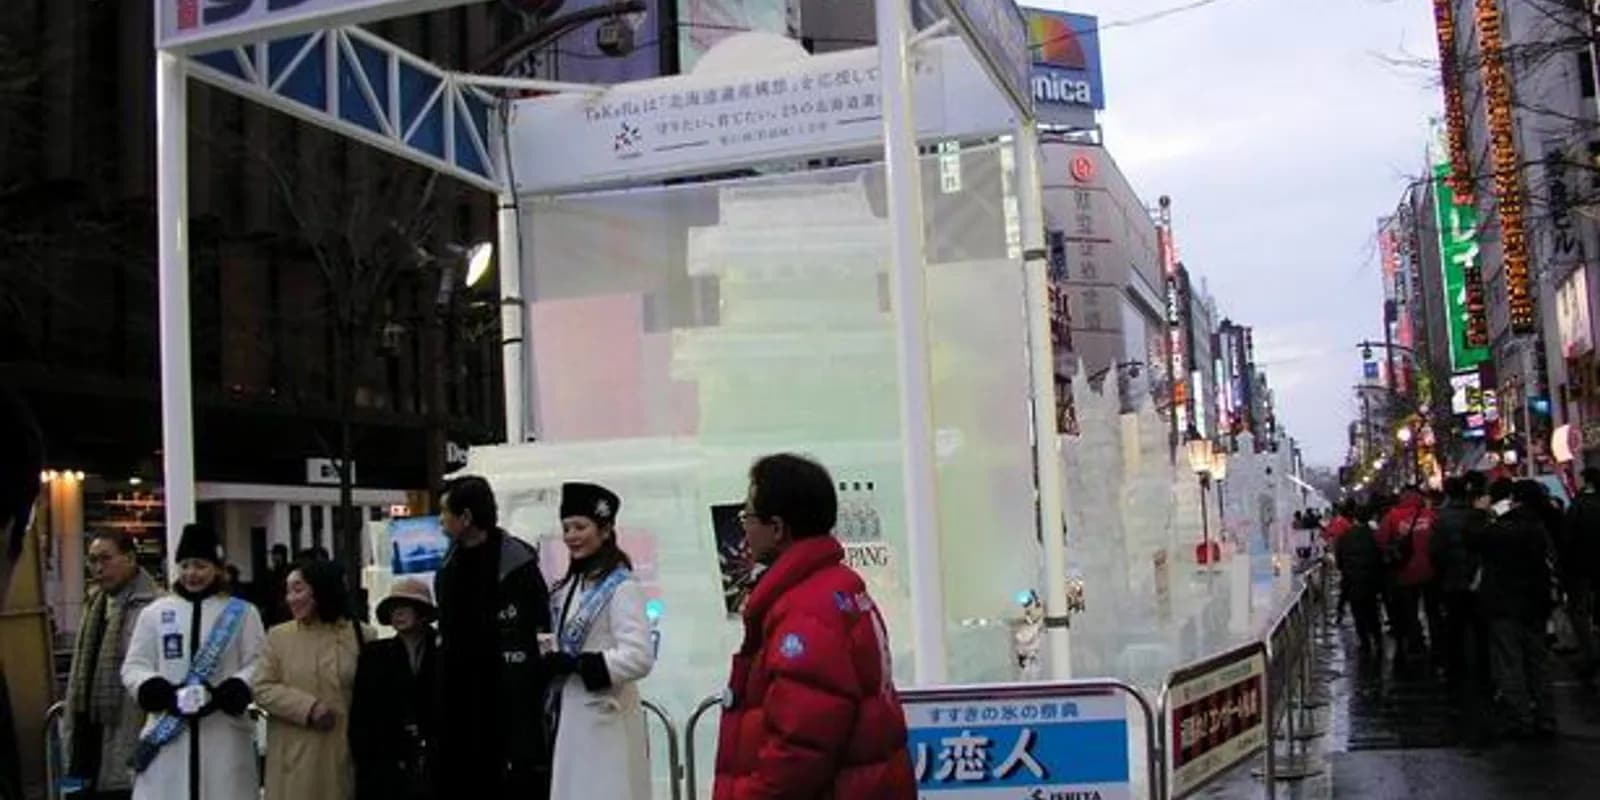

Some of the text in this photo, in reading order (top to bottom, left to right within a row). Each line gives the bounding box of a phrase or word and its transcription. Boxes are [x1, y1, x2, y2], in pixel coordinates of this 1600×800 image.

[930, 702, 1079, 723] すすきの氷の祭典
